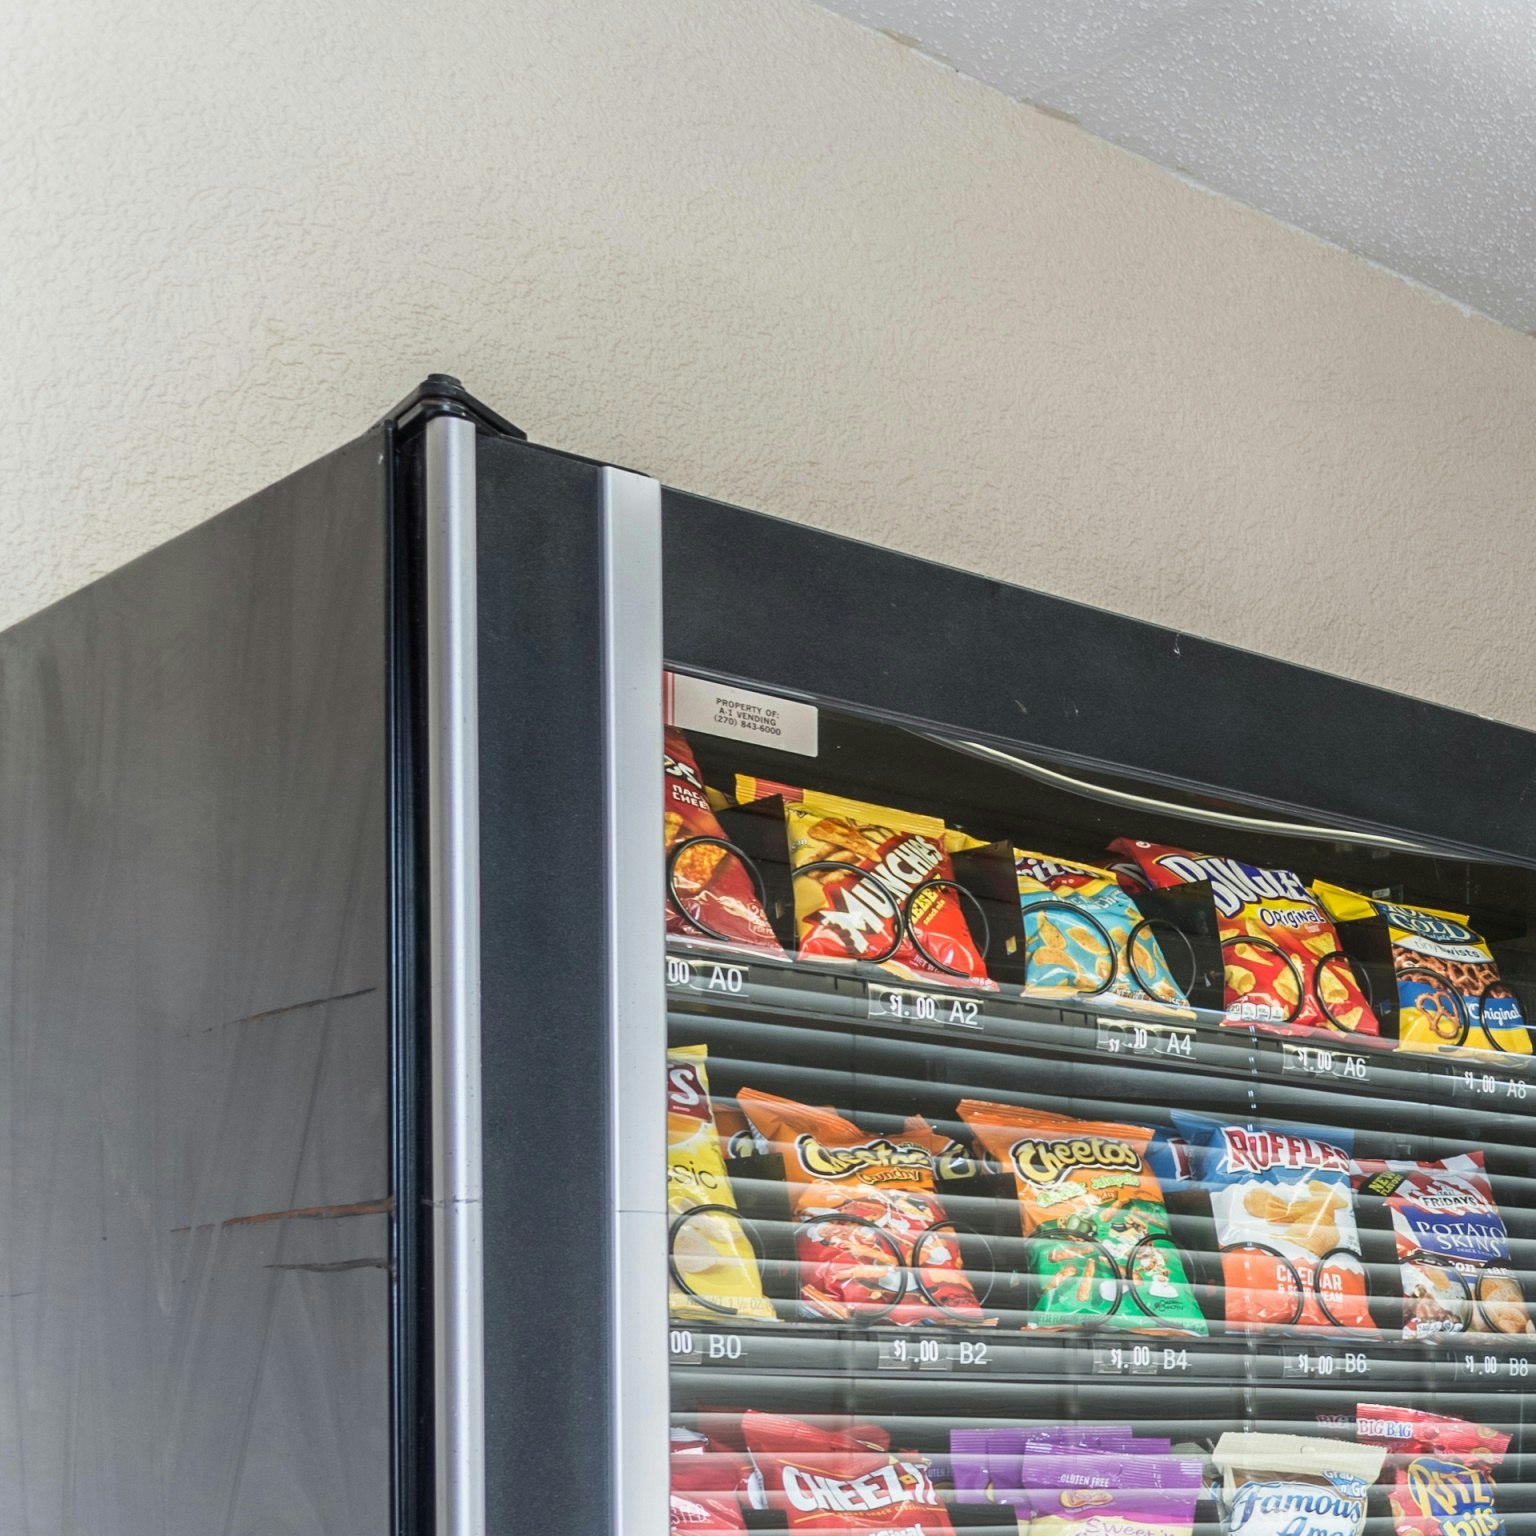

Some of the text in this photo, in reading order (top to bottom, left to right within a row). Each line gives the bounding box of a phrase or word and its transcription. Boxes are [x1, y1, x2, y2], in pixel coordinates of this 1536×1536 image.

[715, 698, 780, 719] PROPERTY OF:
[718, 707, 777, 727] A-1 VENDING
[714, 714, 782, 736] (270) 843-6000
[1391, 912, 1472, 942] GOLD
[709, 967, 743, 991] A0
[950, 1001, 978, 1025] A2
[1167, 1033, 1192, 1055] A4
[1344, 1056, 1367, 1078] A6
[1507, 1080, 1527, 1099] A8
[1014, 1138, 1141, 1185] Cheetos
[1223, 1128, 1350, 1174] RUFFLES
[1416, 1221, 1506, 1245] POTATO
[1436, 1235, 1502, 1258] SKINS
[709, 1336, 742, 1359] B0
[959, 1342, 988, 1365] B2
[1163, 1349, 1188, 1370] B4
[1345, 1353, 1367, 1374] B6
[1509, 1358, 1528, 1377] B8
[1358, 1420, 1412, 1439] BIG BAG
[1061, 1474, 1110, 1488] GLUTEN FREE
[1412, 1464, 1491, 1519] RITZ
[1237, 1488, 1362, 1531] Famous
